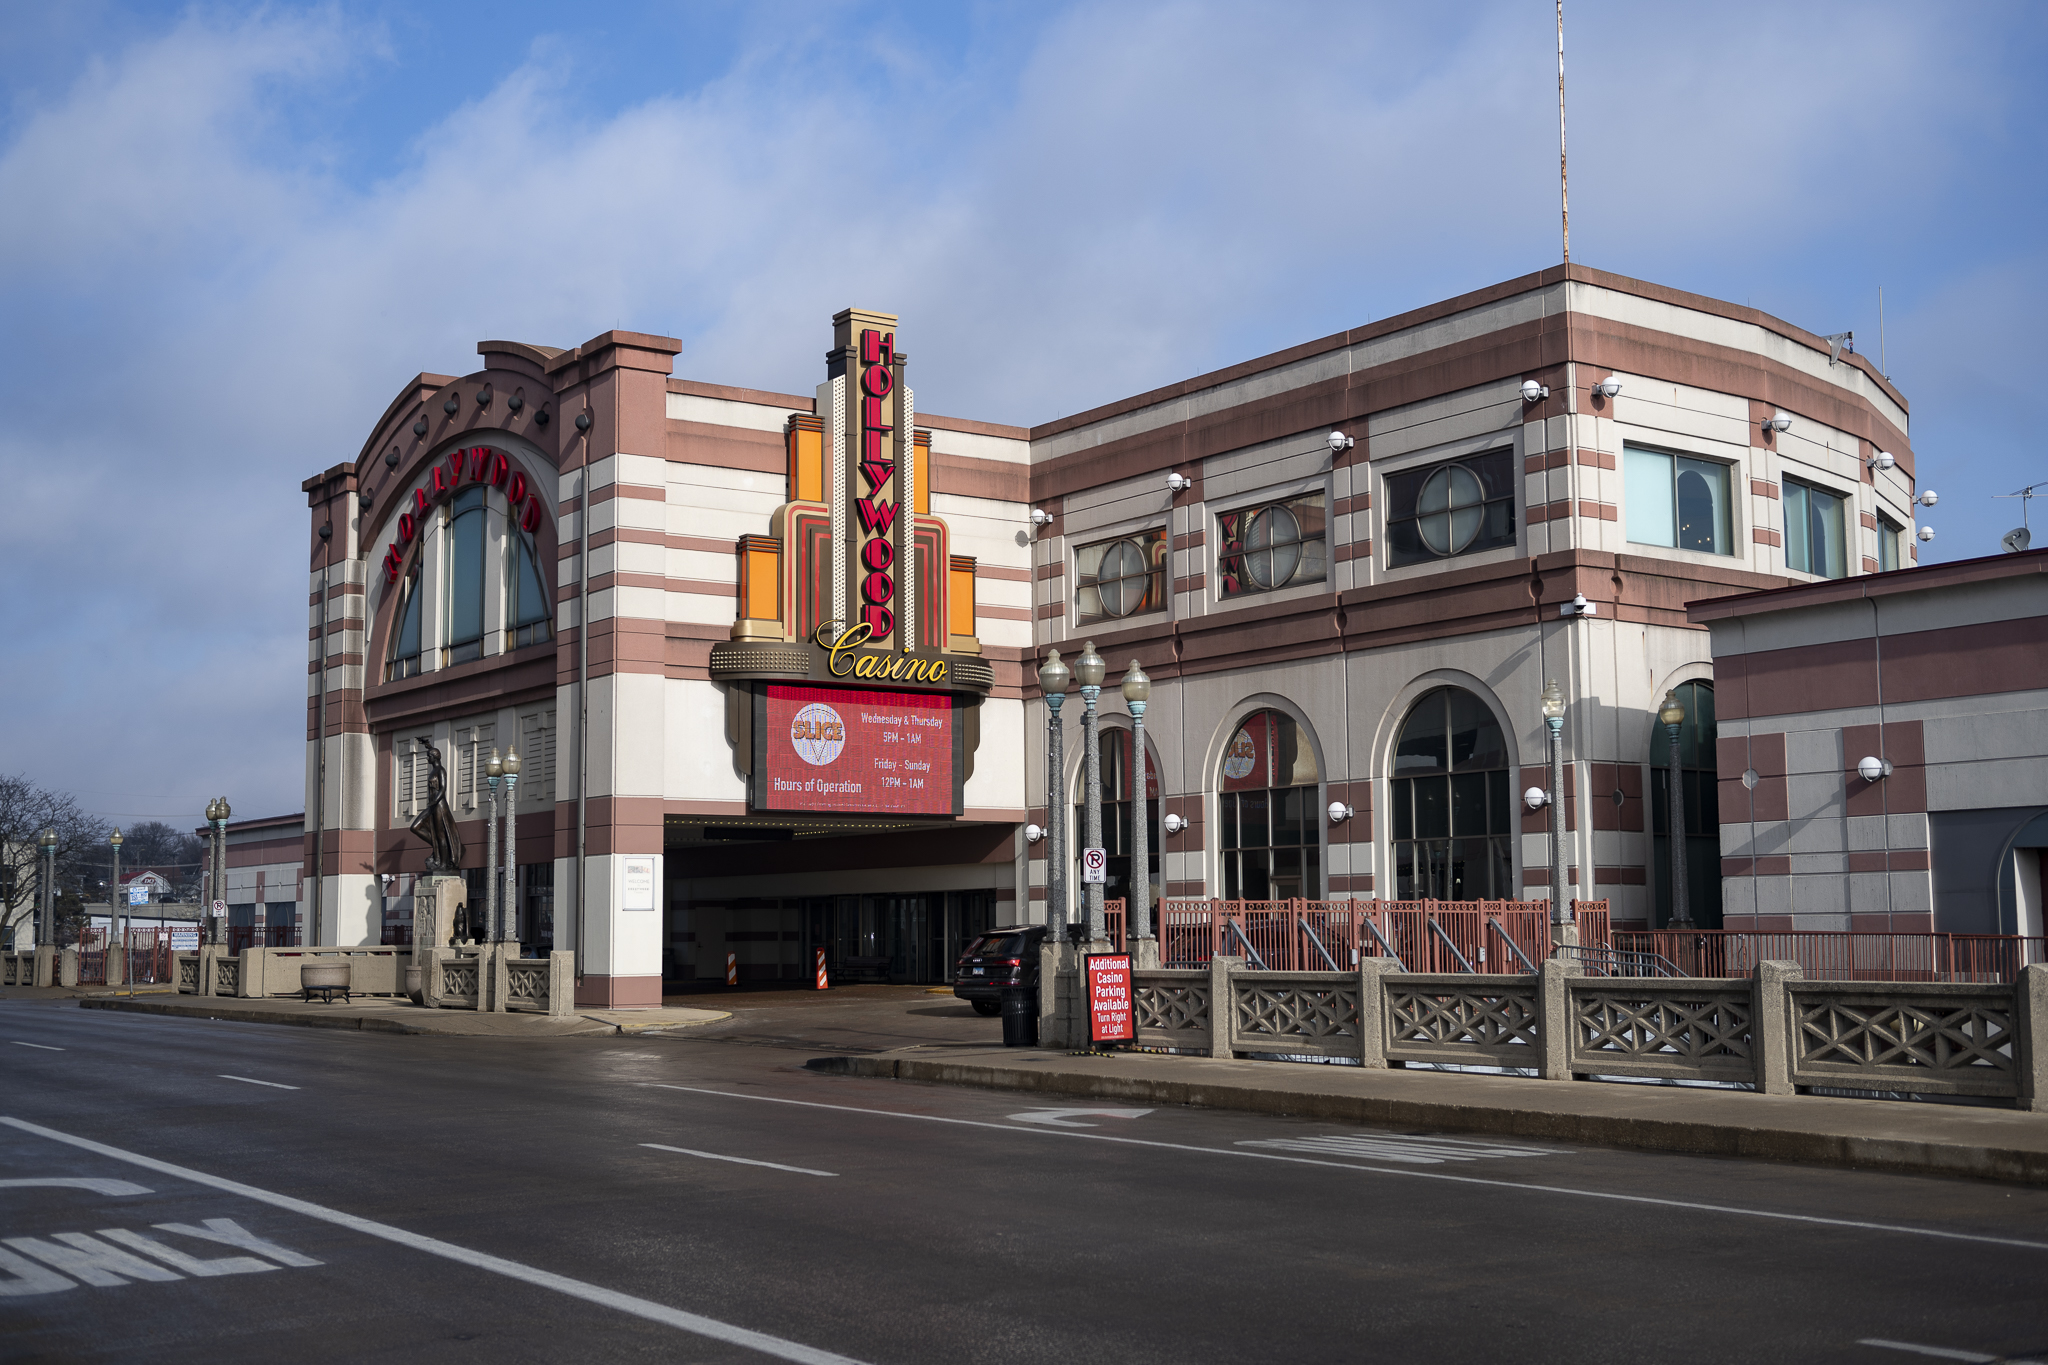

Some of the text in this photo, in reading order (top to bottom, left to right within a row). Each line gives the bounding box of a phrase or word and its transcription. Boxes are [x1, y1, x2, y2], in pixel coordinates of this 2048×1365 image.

[856, 329, 901, 638] HOLLYWOOD
[381, 447, 541, 584] HOLLYWOOD
[816, 619, 948, 683] Casino
[861, 712, 943, 729] Wednesday & Thursday
[793, 720, 843, 742] SLICE
[883, 731, 899, 743] 5PM
[907, 732, 922, 744] 1AM
[874, 757, 897, 772] Friday
[904, 759, 931, 774] Sunday
[774, 777, 862, 796] Hours of Operation
[881, 776, 901, 788] 12PM
[909, 777, 924, 789] 1AM
[1089, 957, 1130, 971] Additional
[1097, 971, 1123, 984] Casino
[1095, 984, 1125, 999] Parking
[1093, 997, 1129, 1012] Available
[1097, 1011, 1127, 1025] Turn Right
[1101, 1023, 1124, 1036] at Light
